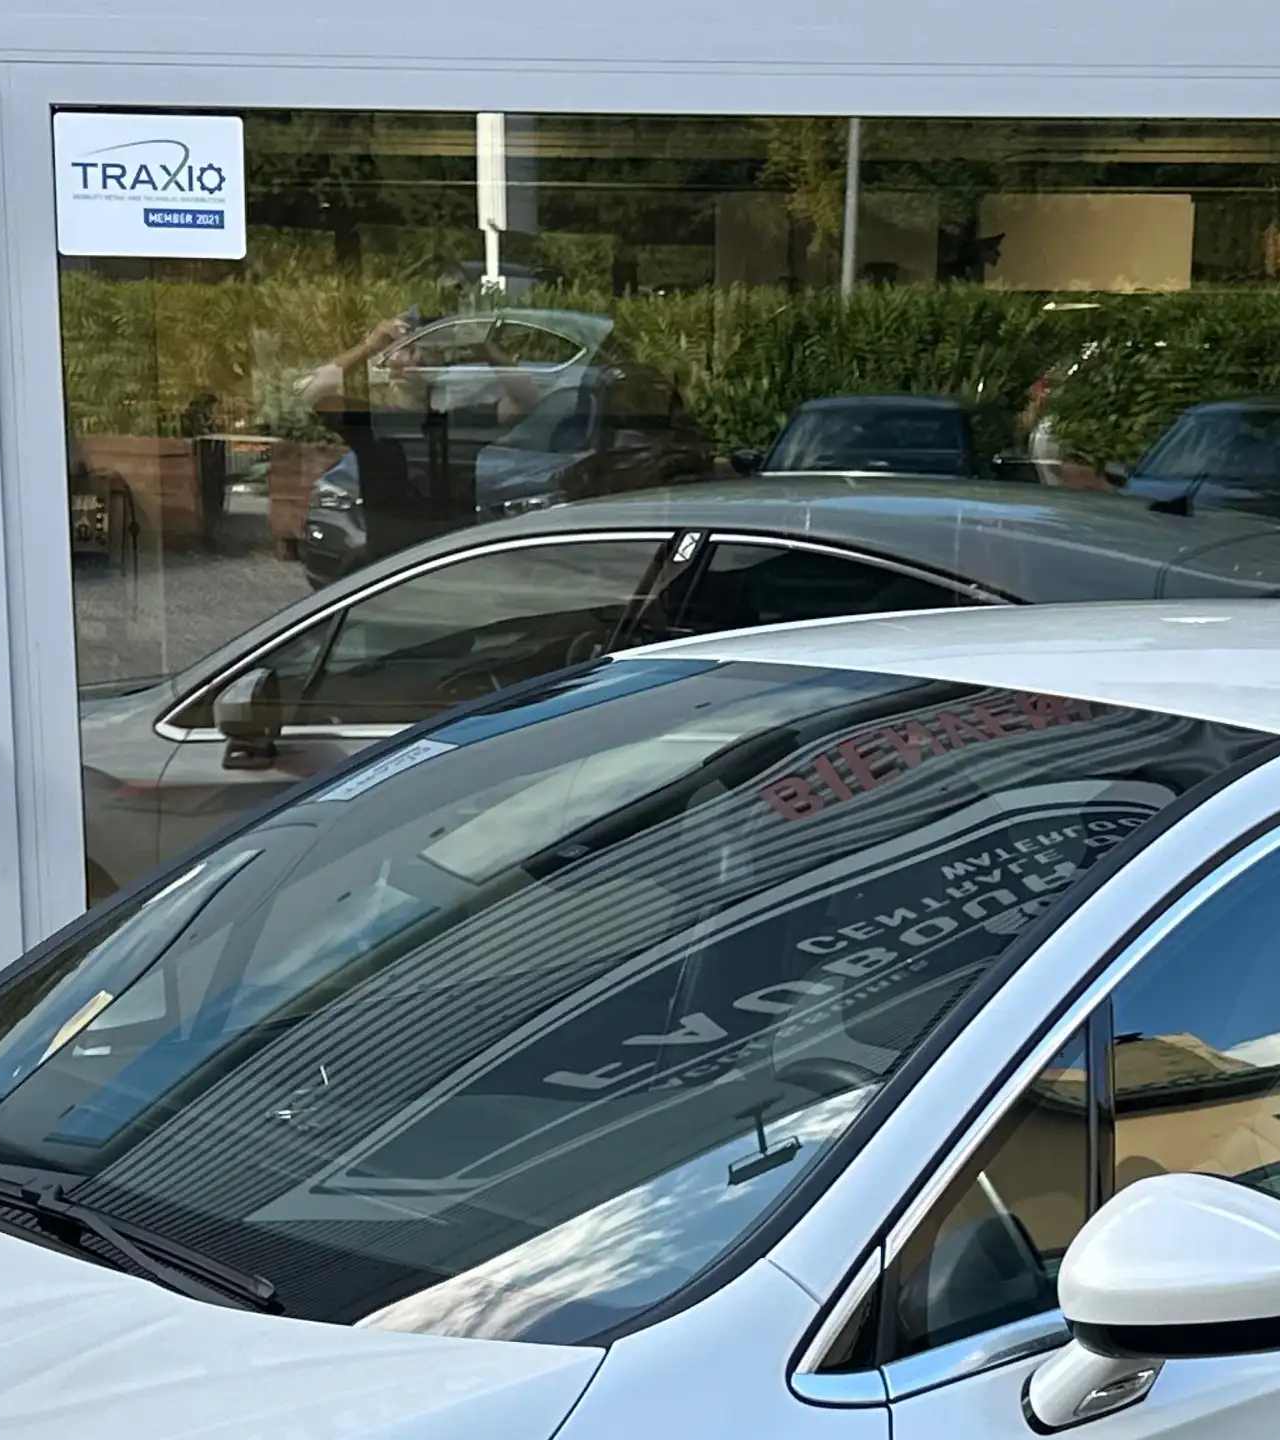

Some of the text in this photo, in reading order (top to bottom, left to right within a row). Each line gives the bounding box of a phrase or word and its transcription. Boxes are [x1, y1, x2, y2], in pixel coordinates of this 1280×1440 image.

[71, 150, 226, 194] TRAXIO
[148, 212, 221, 225] MEMBER 2021
